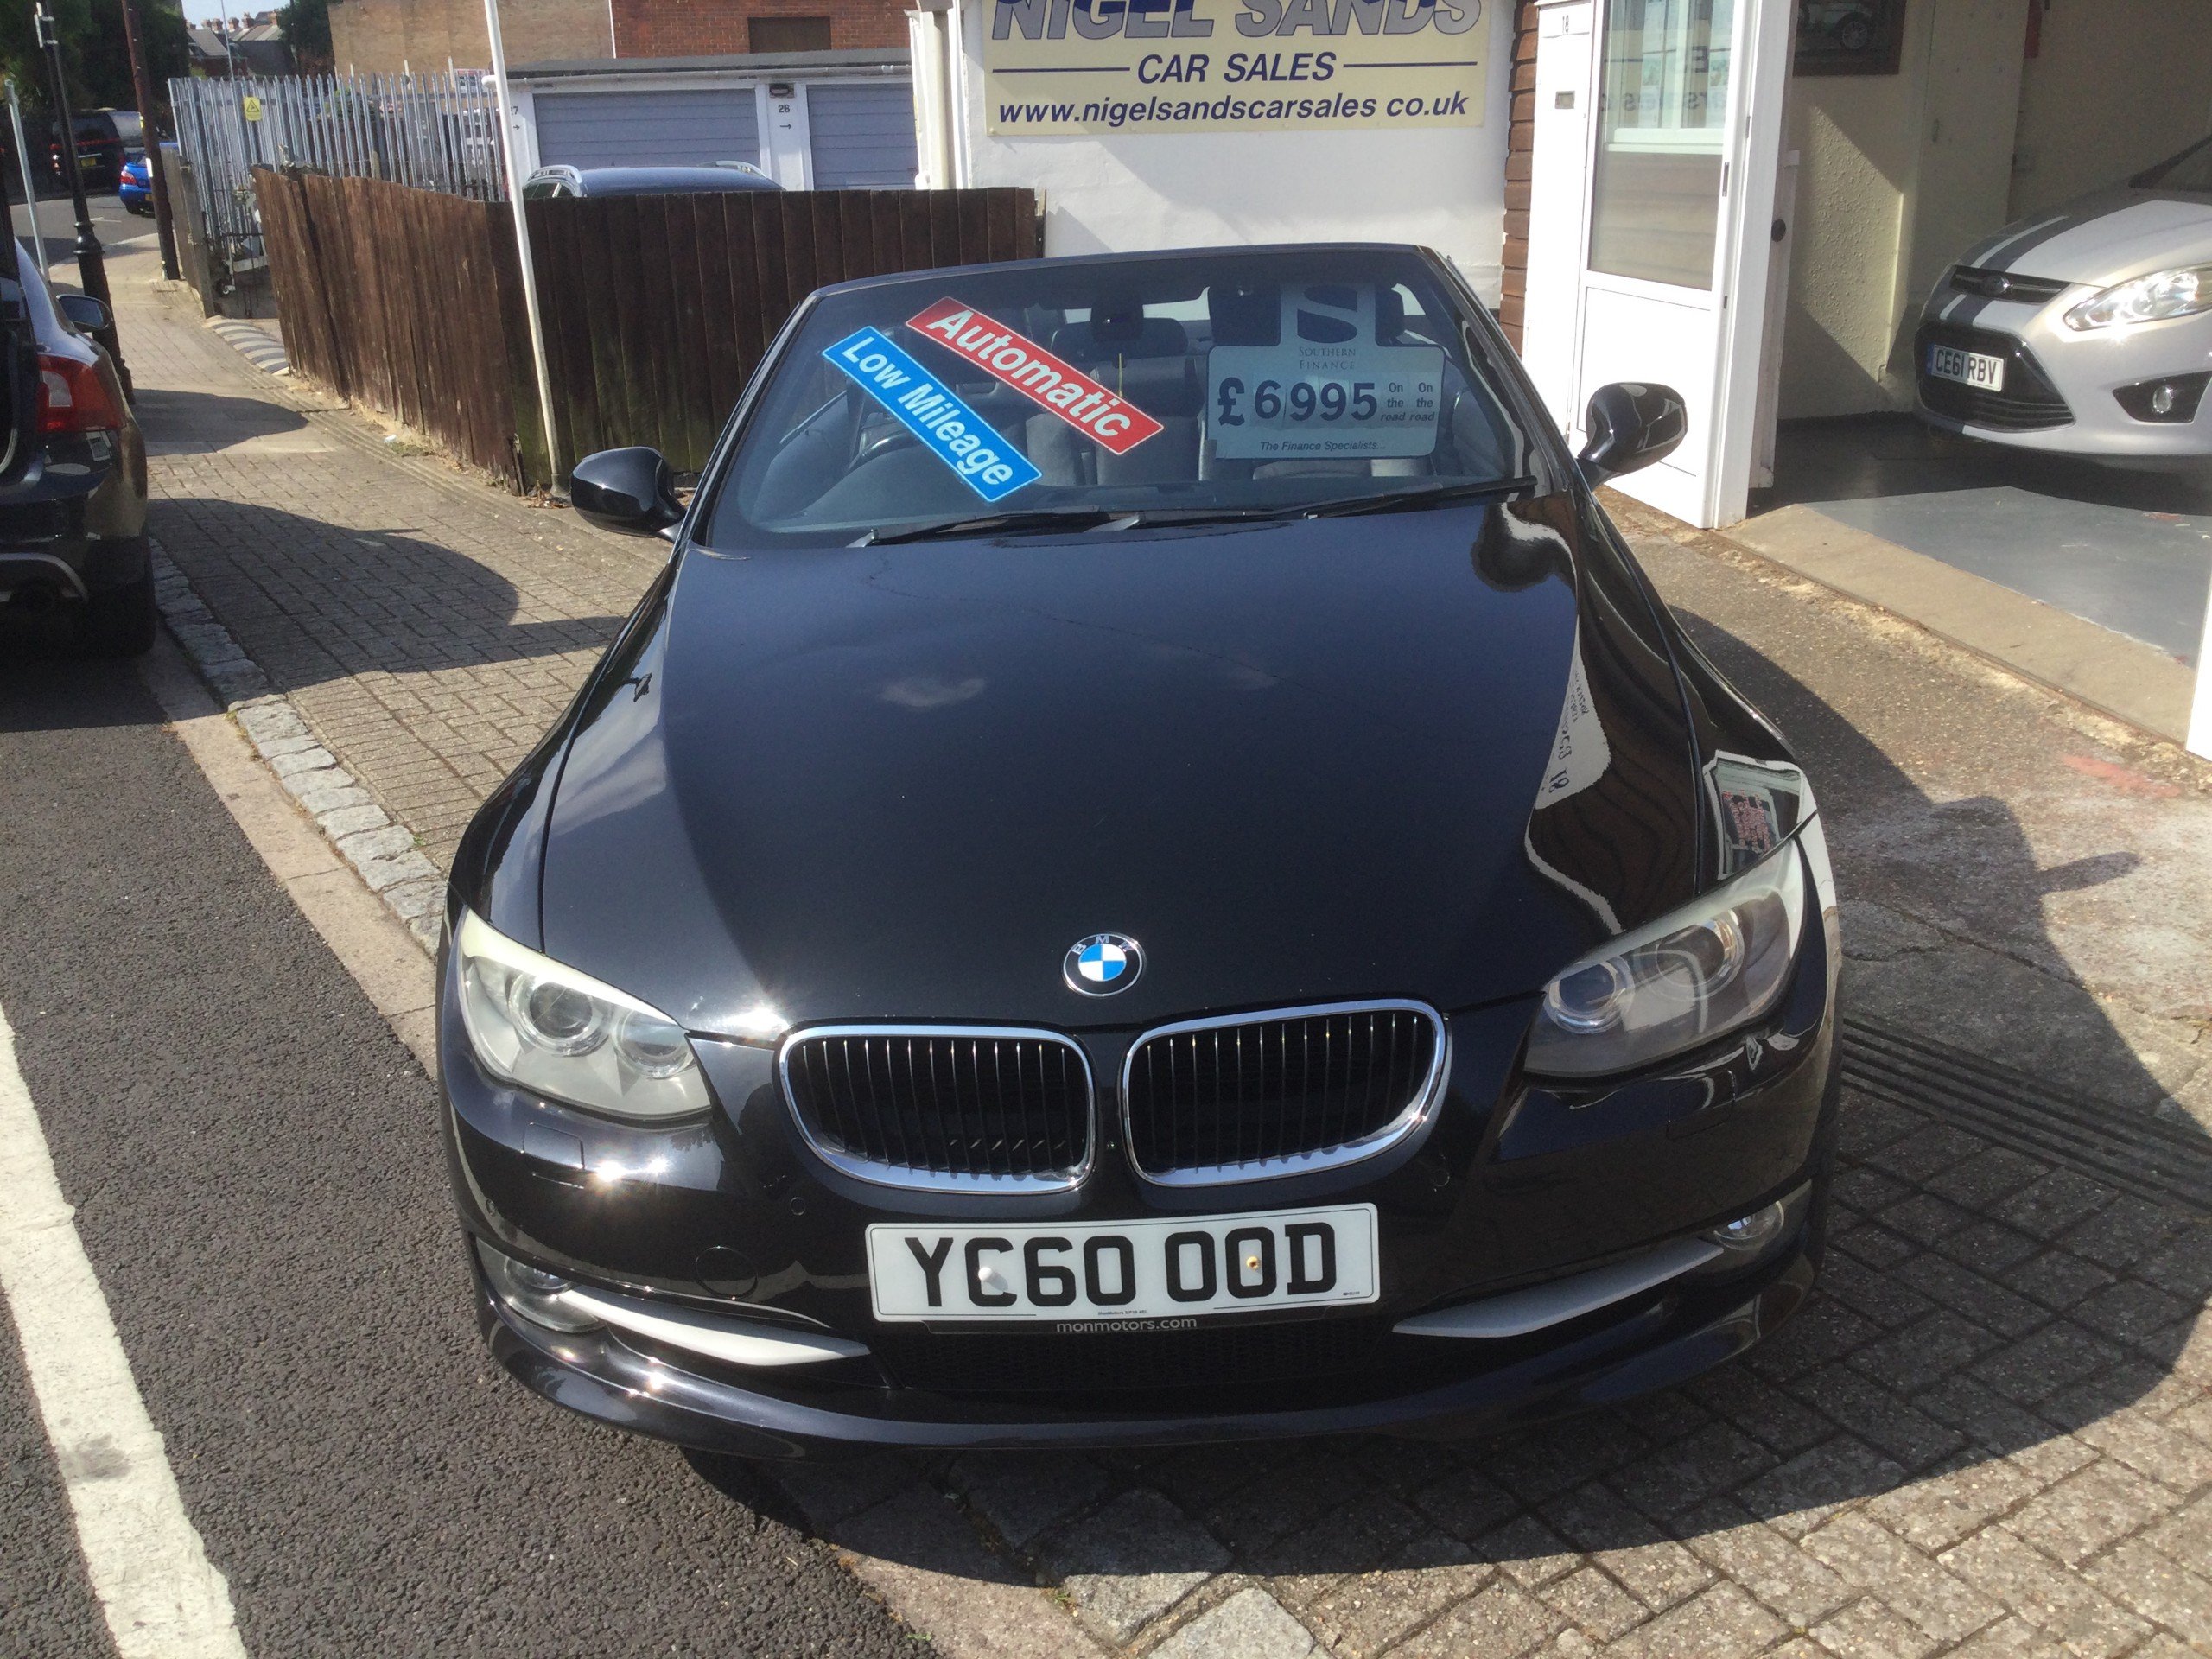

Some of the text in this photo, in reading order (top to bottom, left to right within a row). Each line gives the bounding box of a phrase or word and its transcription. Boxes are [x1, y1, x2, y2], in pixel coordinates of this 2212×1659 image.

[1137, 52, 1337, 84] CAR SALES
[778, 104, 791, 113] 26
[999, 91, 1469, 127] www.nigelsandscarsales co.uk
[1299, 347, 1357, 357] SOUTHERN
[926, 309, 1132, 436] Automatic
[1299, 360, 1355, 370] FINANCE
[1936, 349, 1997, 384] CE61 RBV
[1389, 382, 1433, 393] On On
[1217, 377, 1377, 426] £6995
[1387, 397, 1433, 408] the the
[842, 336, 1014, 486] Low Mileage
[1380, 411, 1435, 422] road road
[1260, 442, 1279, 451] The
[1281, 441, 1321, 451] Finance
[1071, 934, 1136, 955] BMW
[904, 1236, 1136, 1307] YC60
[1057, 1318, 1197, 1332] monmotors.com
